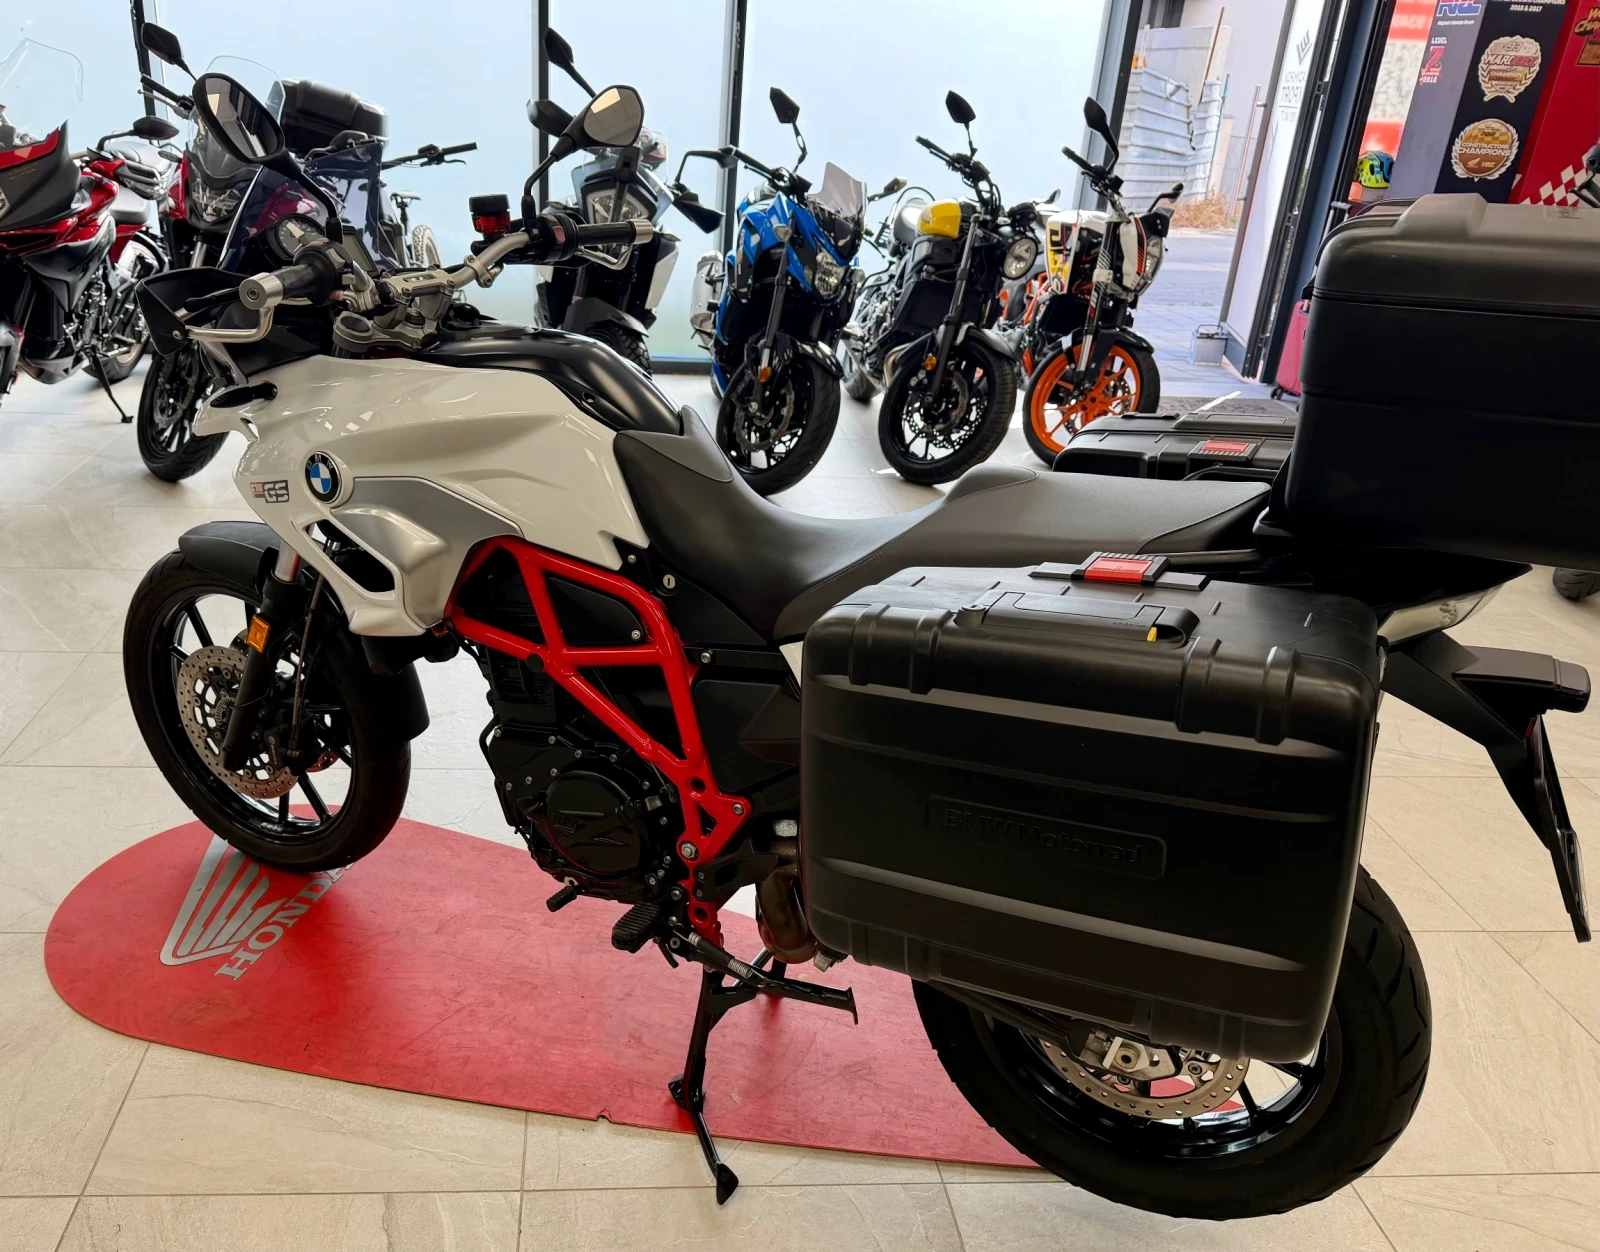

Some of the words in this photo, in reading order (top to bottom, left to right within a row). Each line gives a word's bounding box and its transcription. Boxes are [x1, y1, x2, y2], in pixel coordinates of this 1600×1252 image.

[1458, 147, 1512, 156] CHAMPIONS
[944, 808, 1014, 840] BMW
[1018, 822, 1144, 864] Motorrad
